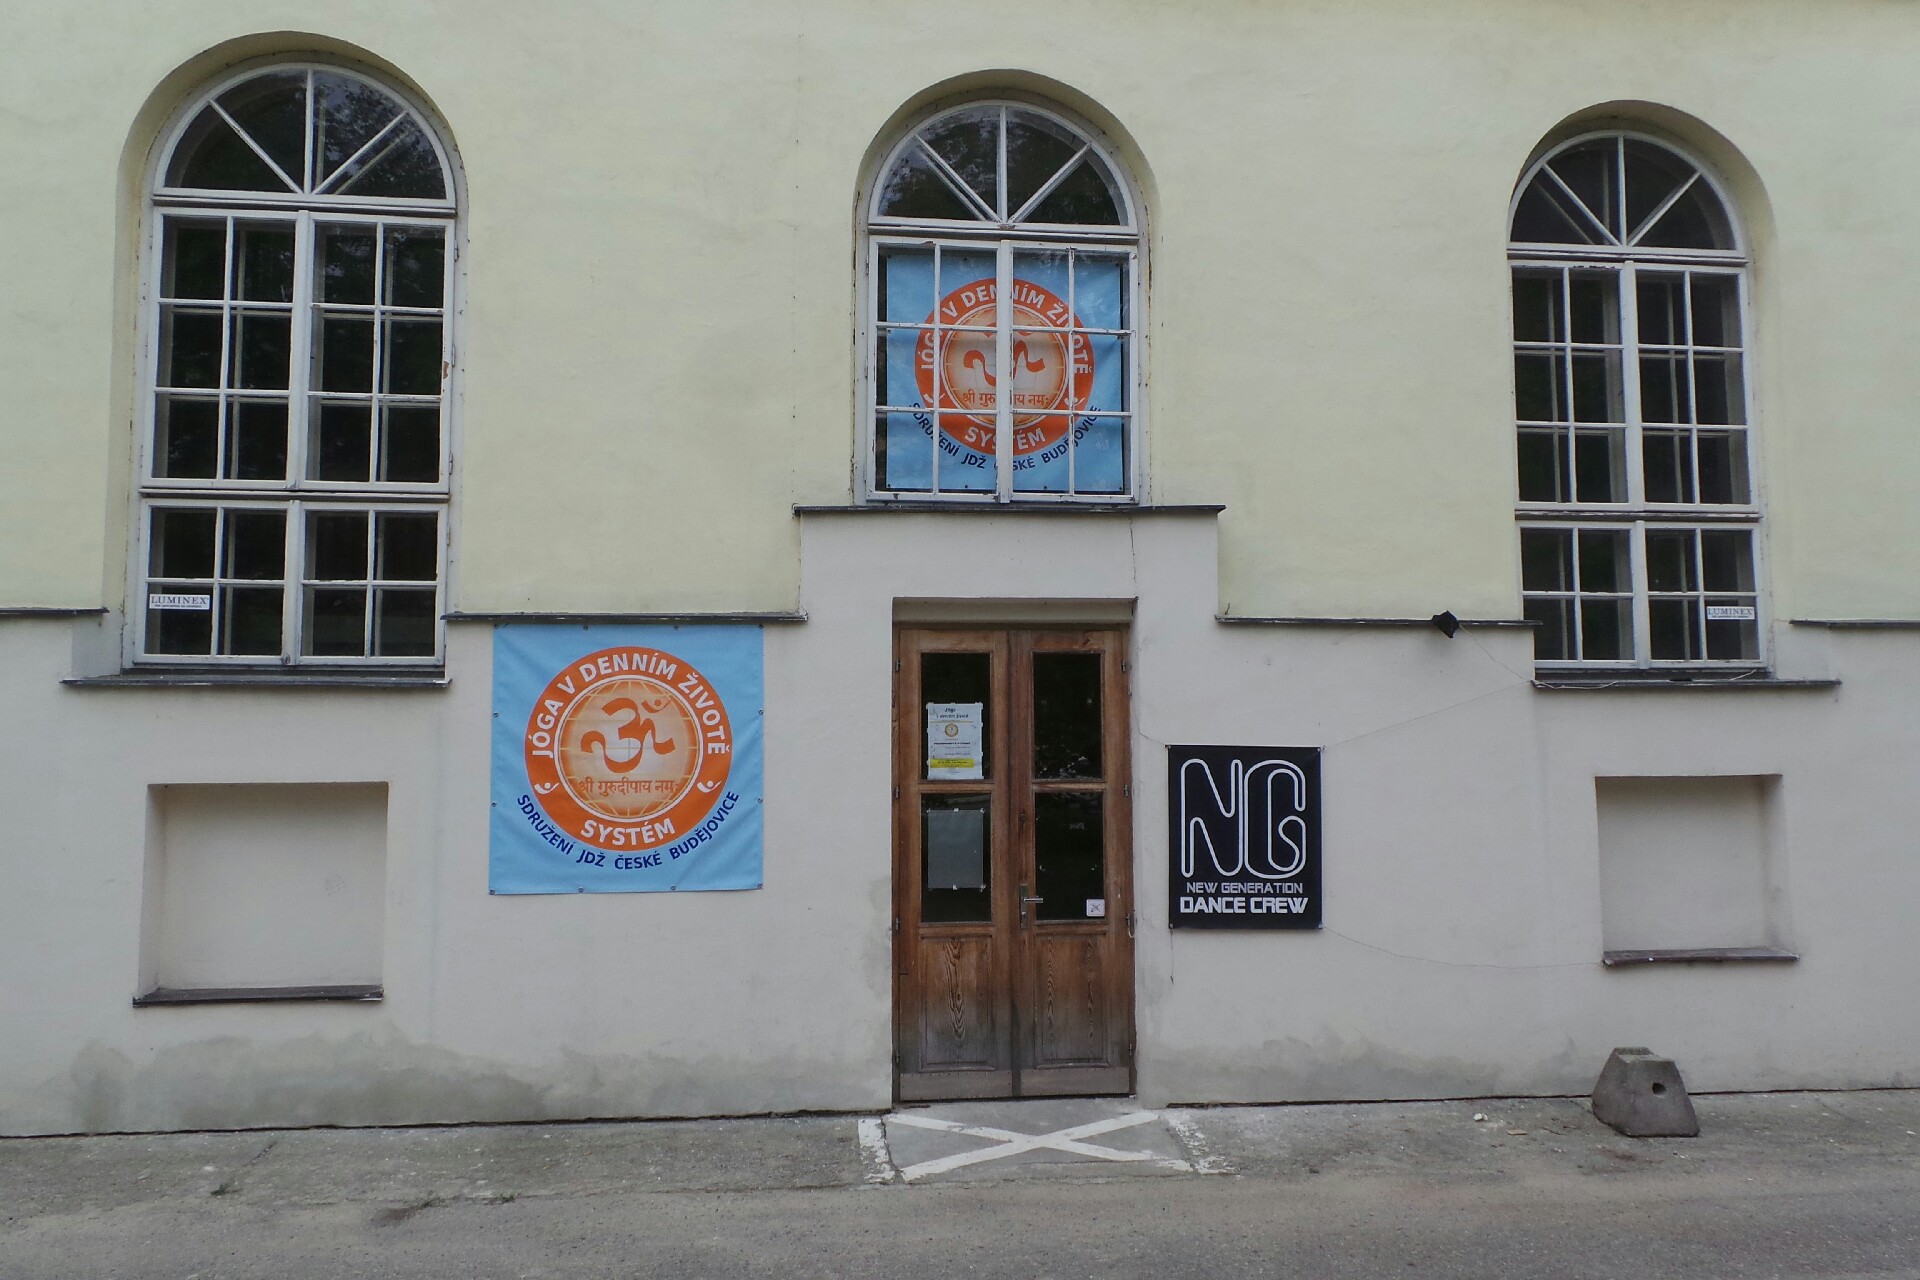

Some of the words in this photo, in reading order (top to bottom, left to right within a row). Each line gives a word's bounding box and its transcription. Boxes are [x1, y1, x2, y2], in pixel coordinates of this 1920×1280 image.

[941, 300, 958, 318] V
[961, 452, 988, 469] JDŽ
[528, 698, 564, 759] JÓGA
[556, 675, 577, 696] V
[578, 652, 678, 684] DENNÍM
[677, 671, 730, 755] ŽIVOTĚ
[516, 793, 578, 855] SDRUŽENÍ
[576, 848, 607, 868] JDŽ
[614, 850, 663, 870] ČESKÉ
[669, 790, 740, 860] BUDĚJOVICE
[1181, 758, 1306, 880] NG
[579, 817, 676, 847] SYSTÉM
[1186, 882, 1218, 894] NEW
[1221, 882, 1303, 894] GENERATION
[1180, 896, 1246, 914] DANCE
[1249, 896, 1308, 914] CREW
